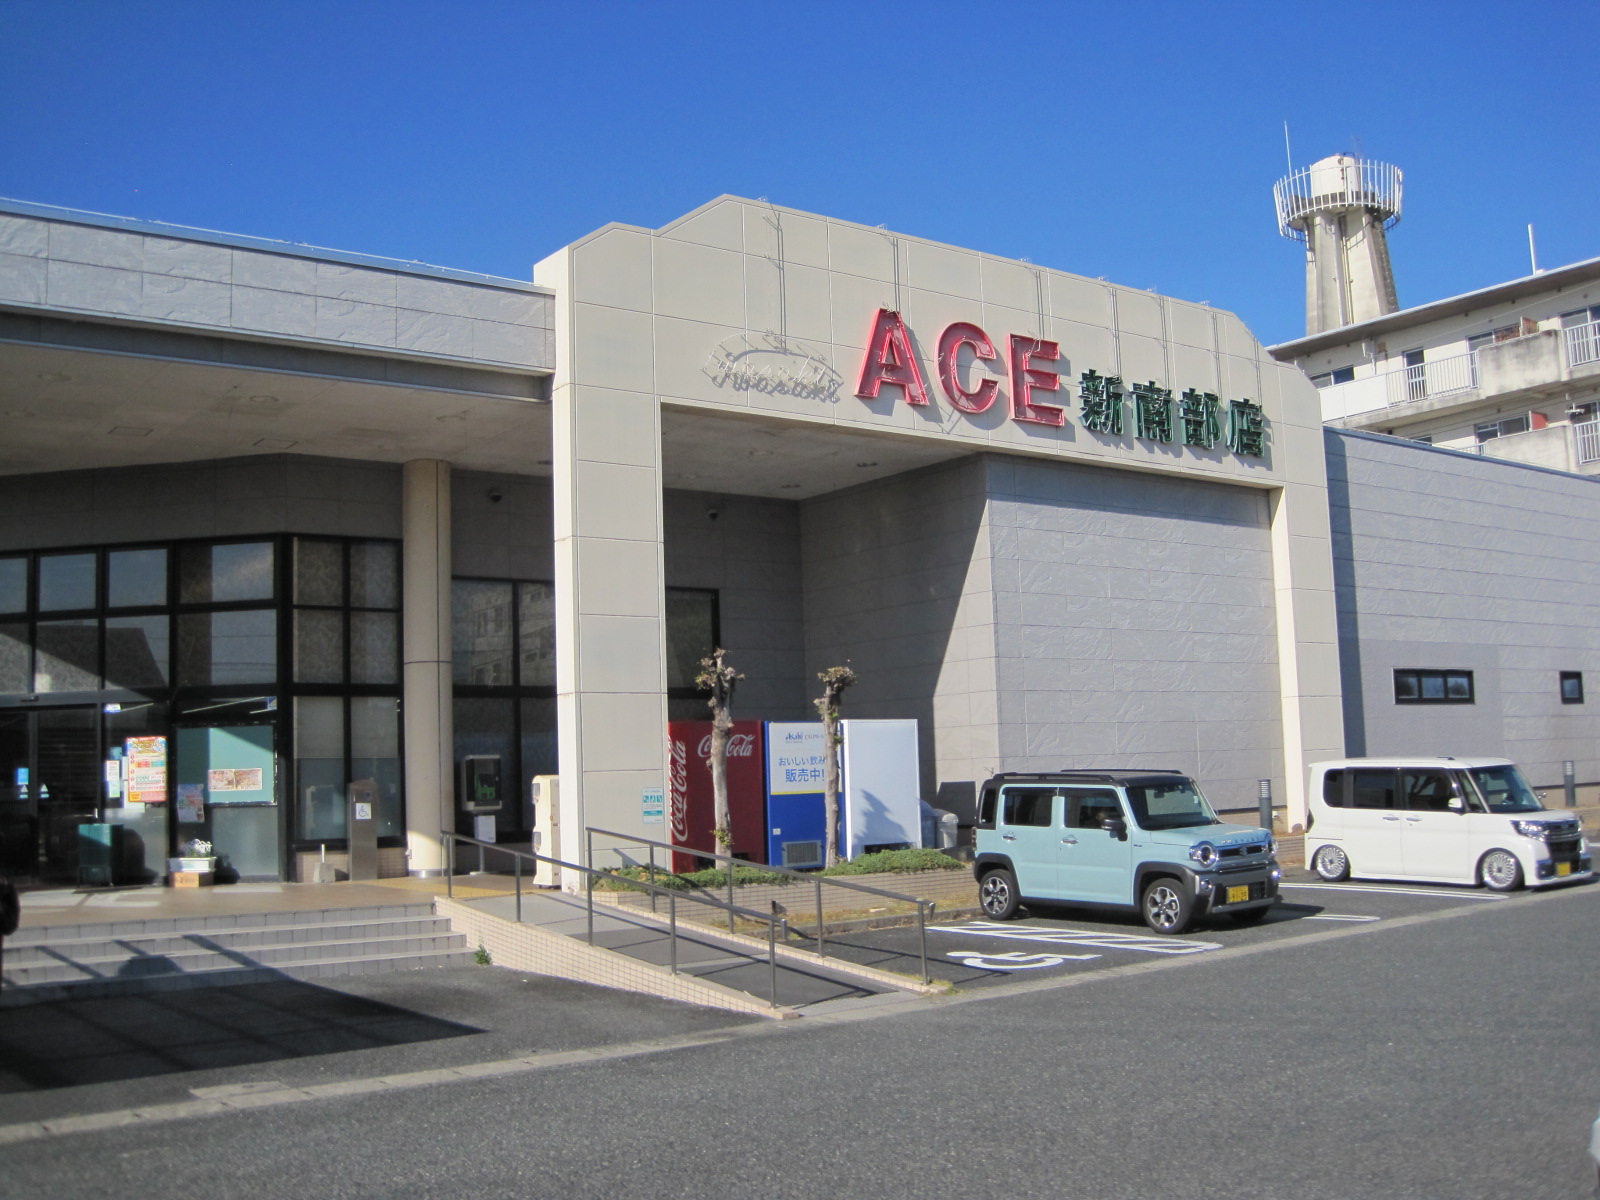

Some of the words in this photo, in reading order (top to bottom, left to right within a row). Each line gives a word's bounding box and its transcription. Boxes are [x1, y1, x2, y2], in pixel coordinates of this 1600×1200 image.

[854, 308, 1065, 426] ACE
[1078, 369, 1264, 457] 新南部店
[697, 734, 756, 758] CoCola
[778, 755, 826, 767] おいしい飲み
[669, 736, 688, 842] Coca-Cola
[785, 767, 825, 783] 販売中!
